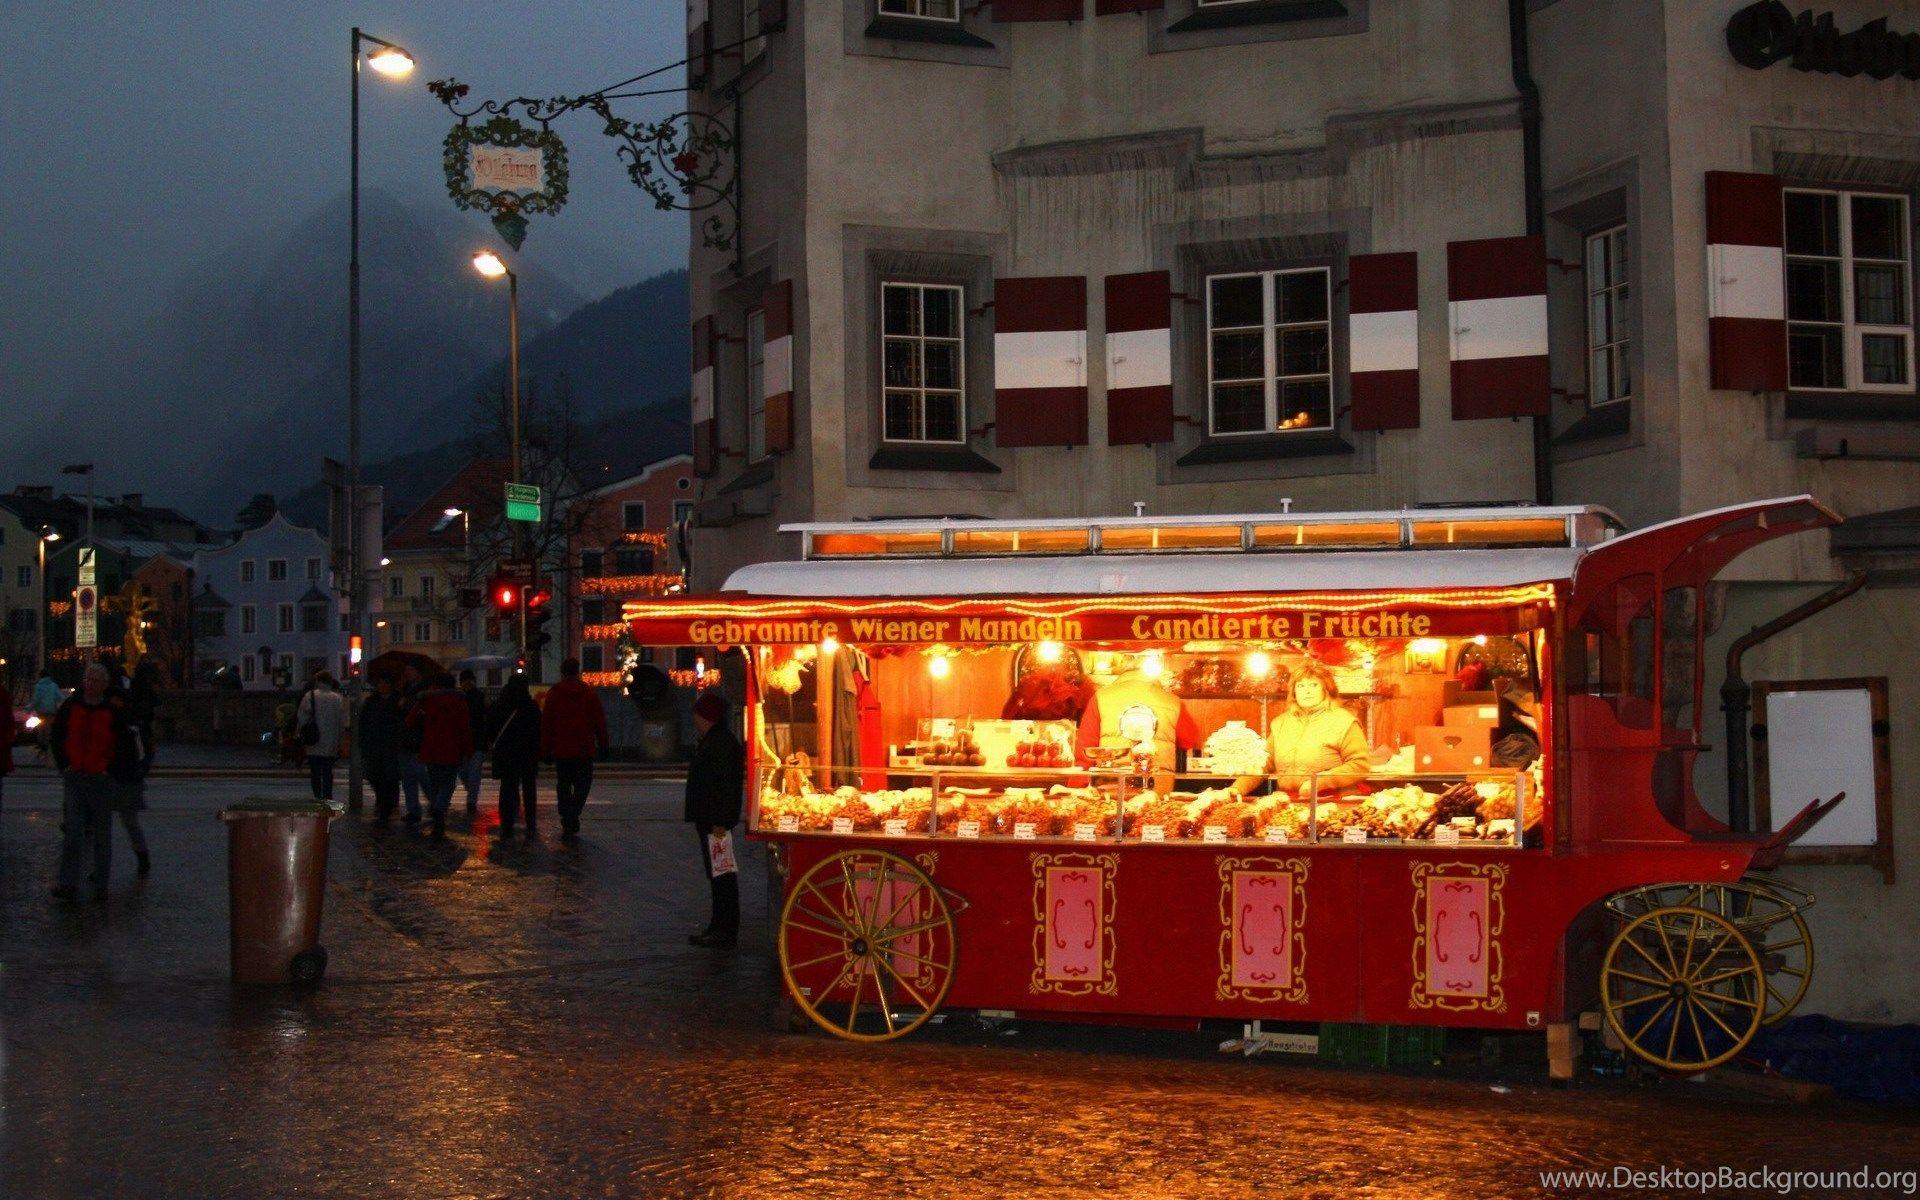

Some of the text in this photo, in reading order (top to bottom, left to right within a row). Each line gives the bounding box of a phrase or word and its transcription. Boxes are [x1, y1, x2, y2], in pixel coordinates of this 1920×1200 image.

[688, 612, 1431, 643] Gebrannte Wiener Mandeln Candierte Früchte
